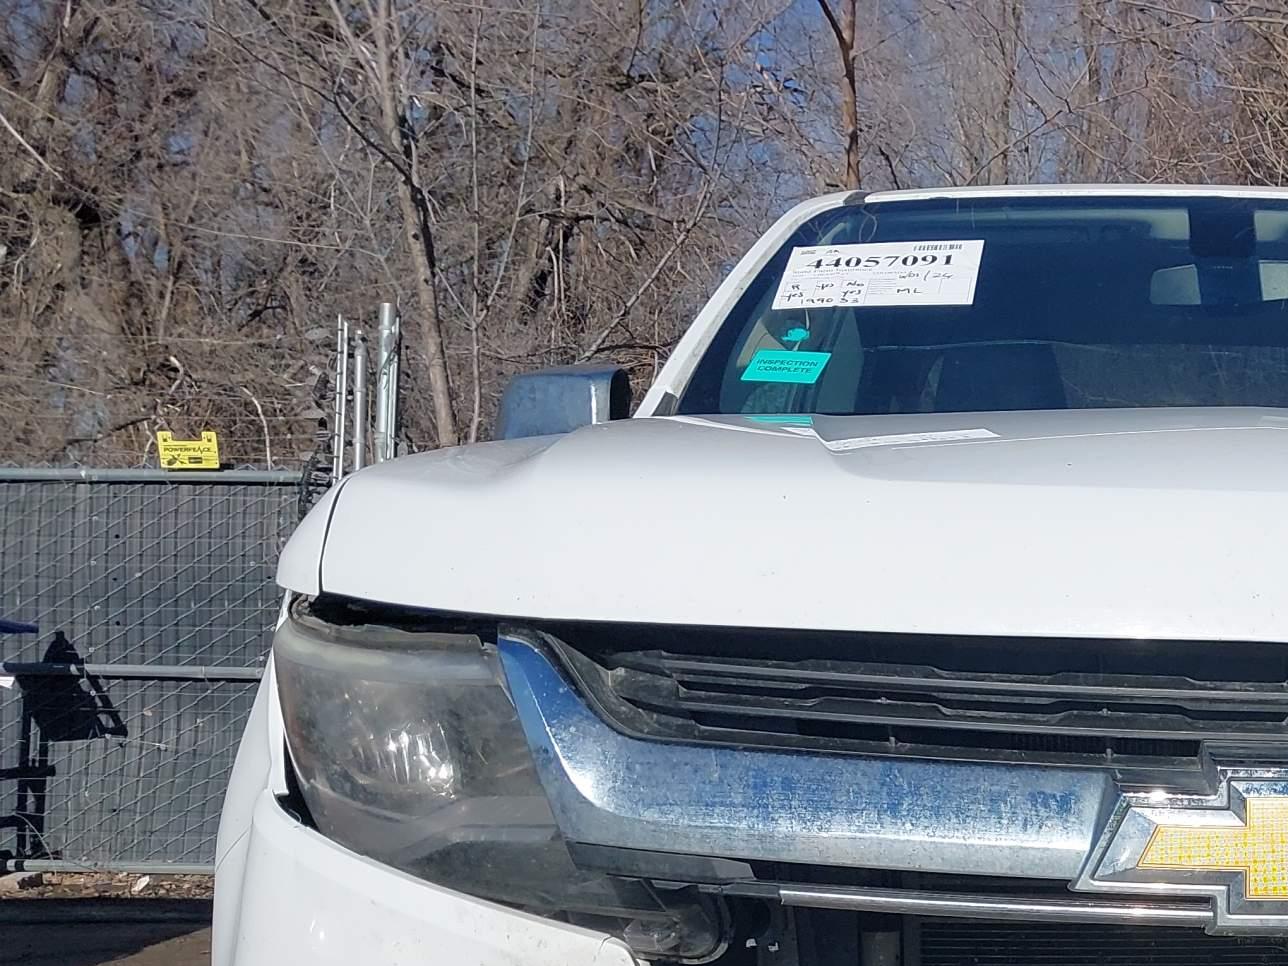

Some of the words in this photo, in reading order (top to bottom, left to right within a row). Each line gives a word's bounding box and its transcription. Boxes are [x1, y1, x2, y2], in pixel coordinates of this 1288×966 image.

[806, 254, 954, 269] 44057091
[756, 358, 819, 367] INSPECTION
[757, 365, 812, 374] COMPLETE
